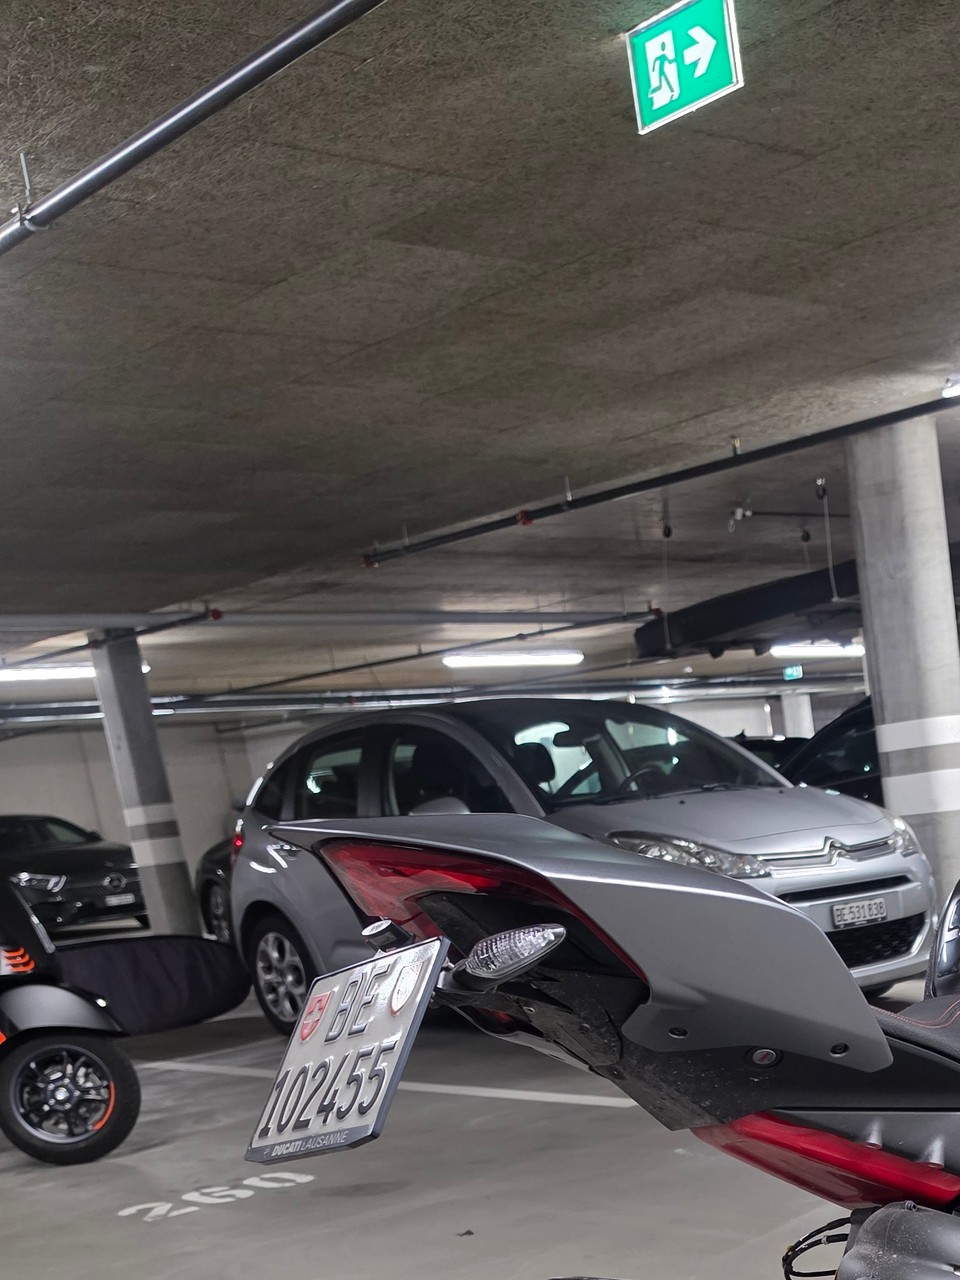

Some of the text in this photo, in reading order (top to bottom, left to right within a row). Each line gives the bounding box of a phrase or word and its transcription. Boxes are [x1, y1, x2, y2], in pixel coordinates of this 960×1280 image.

[325, 963, 391, 1042] BE
[258, 1039, 399, 1138] 102455
[271, 1131, 349, 1157] DUCATI LAUSANNE
